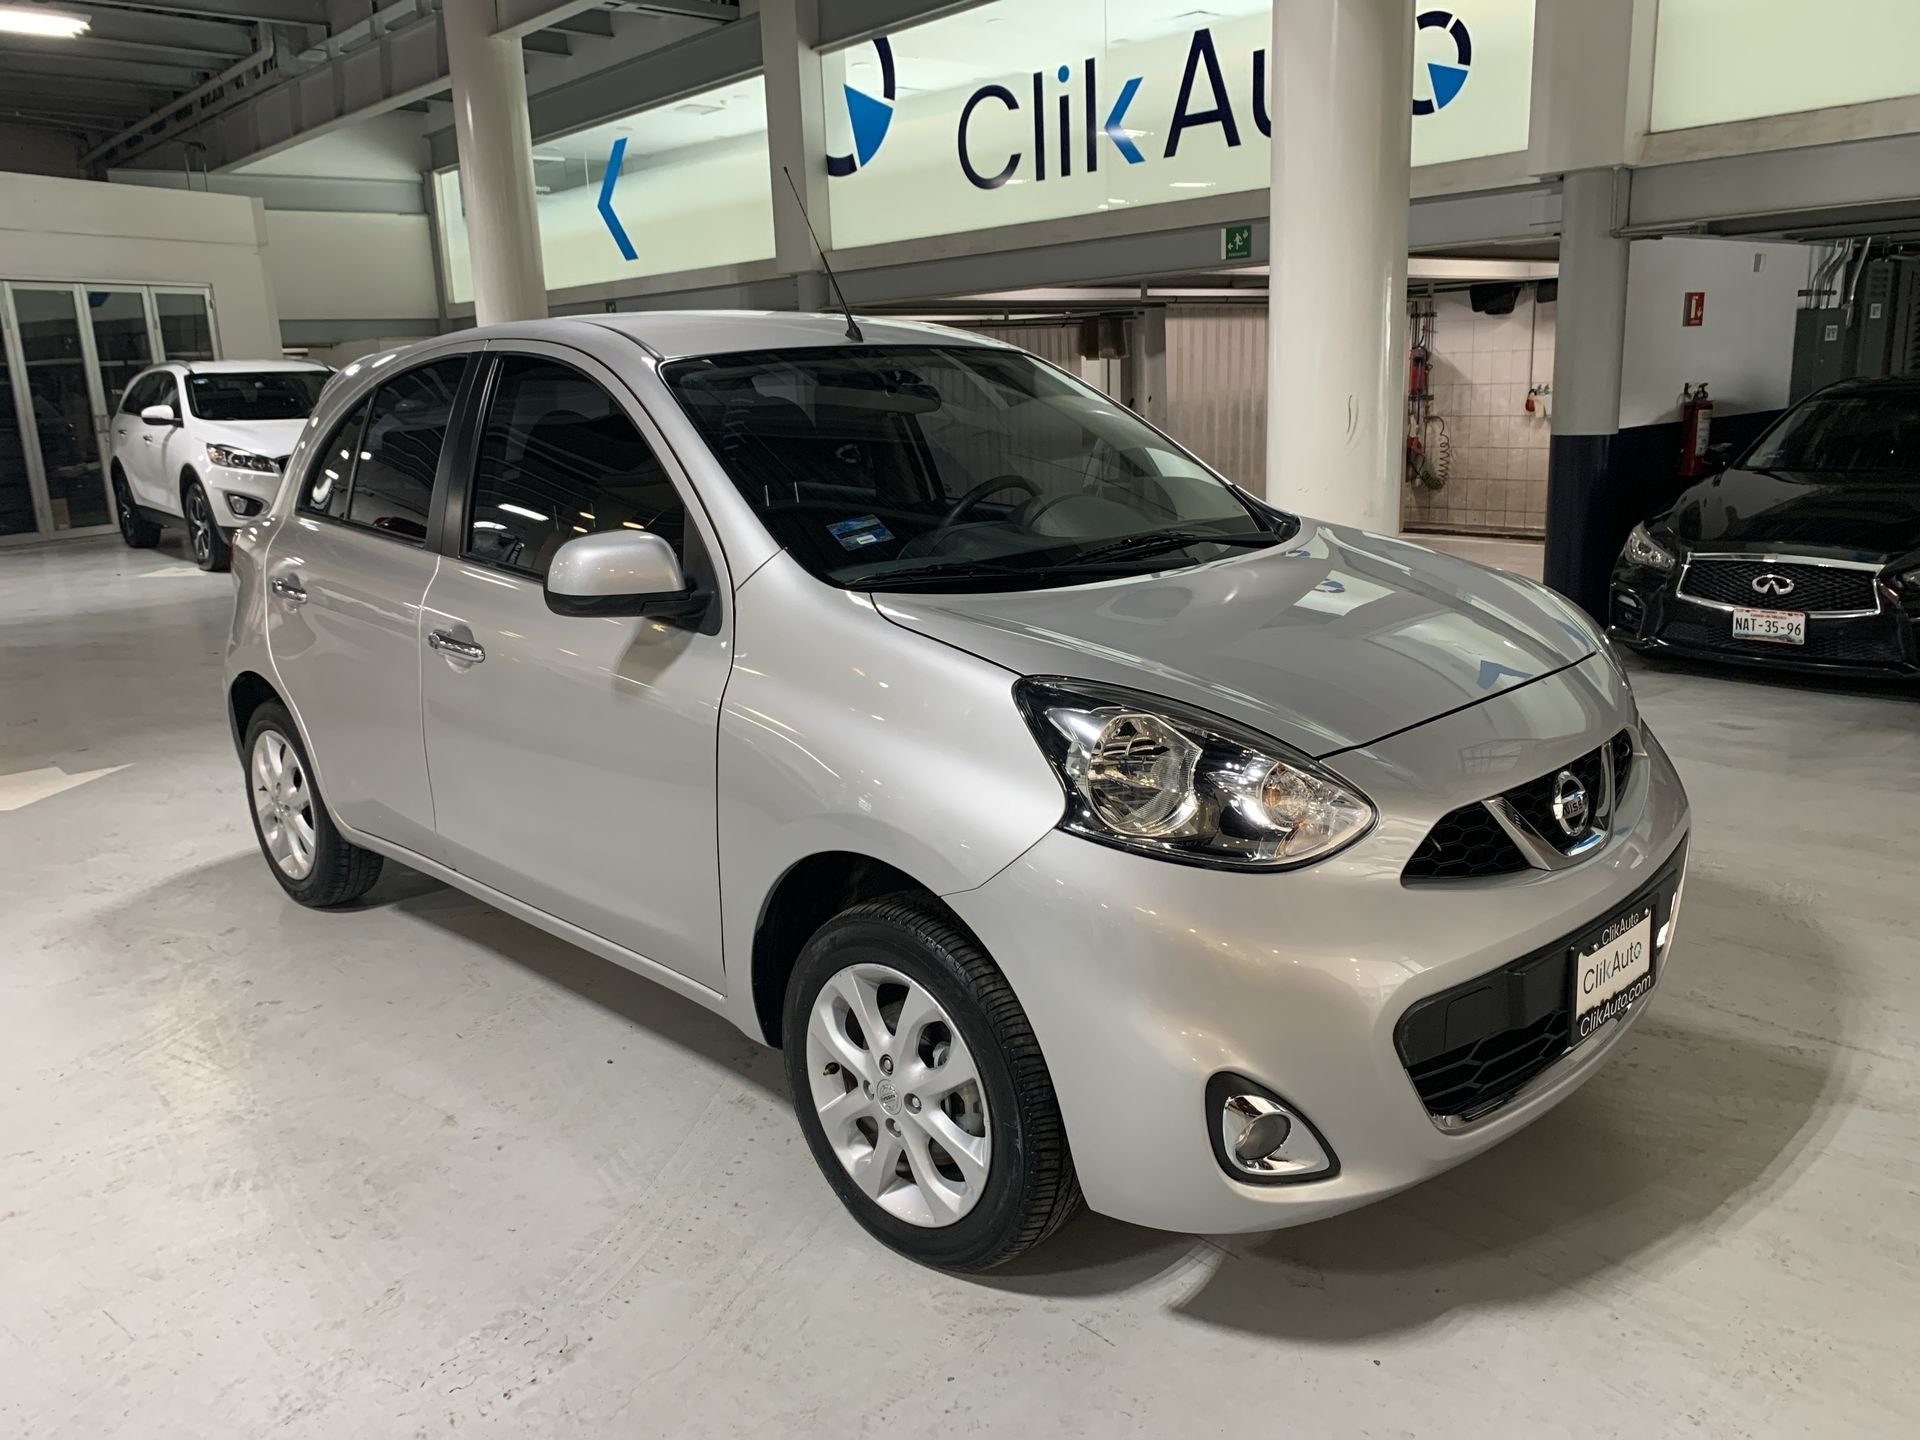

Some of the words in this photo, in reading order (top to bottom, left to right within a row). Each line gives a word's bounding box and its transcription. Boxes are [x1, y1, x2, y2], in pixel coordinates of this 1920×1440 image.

[1735, 617, 1802, 637] NAT-35-96
[1601, 912, 1639, 946] ClikAuto
[1583, 941, 1642, 994] ClikAuto
[1580, 975, 1651, 1037] ClikAuto.com
